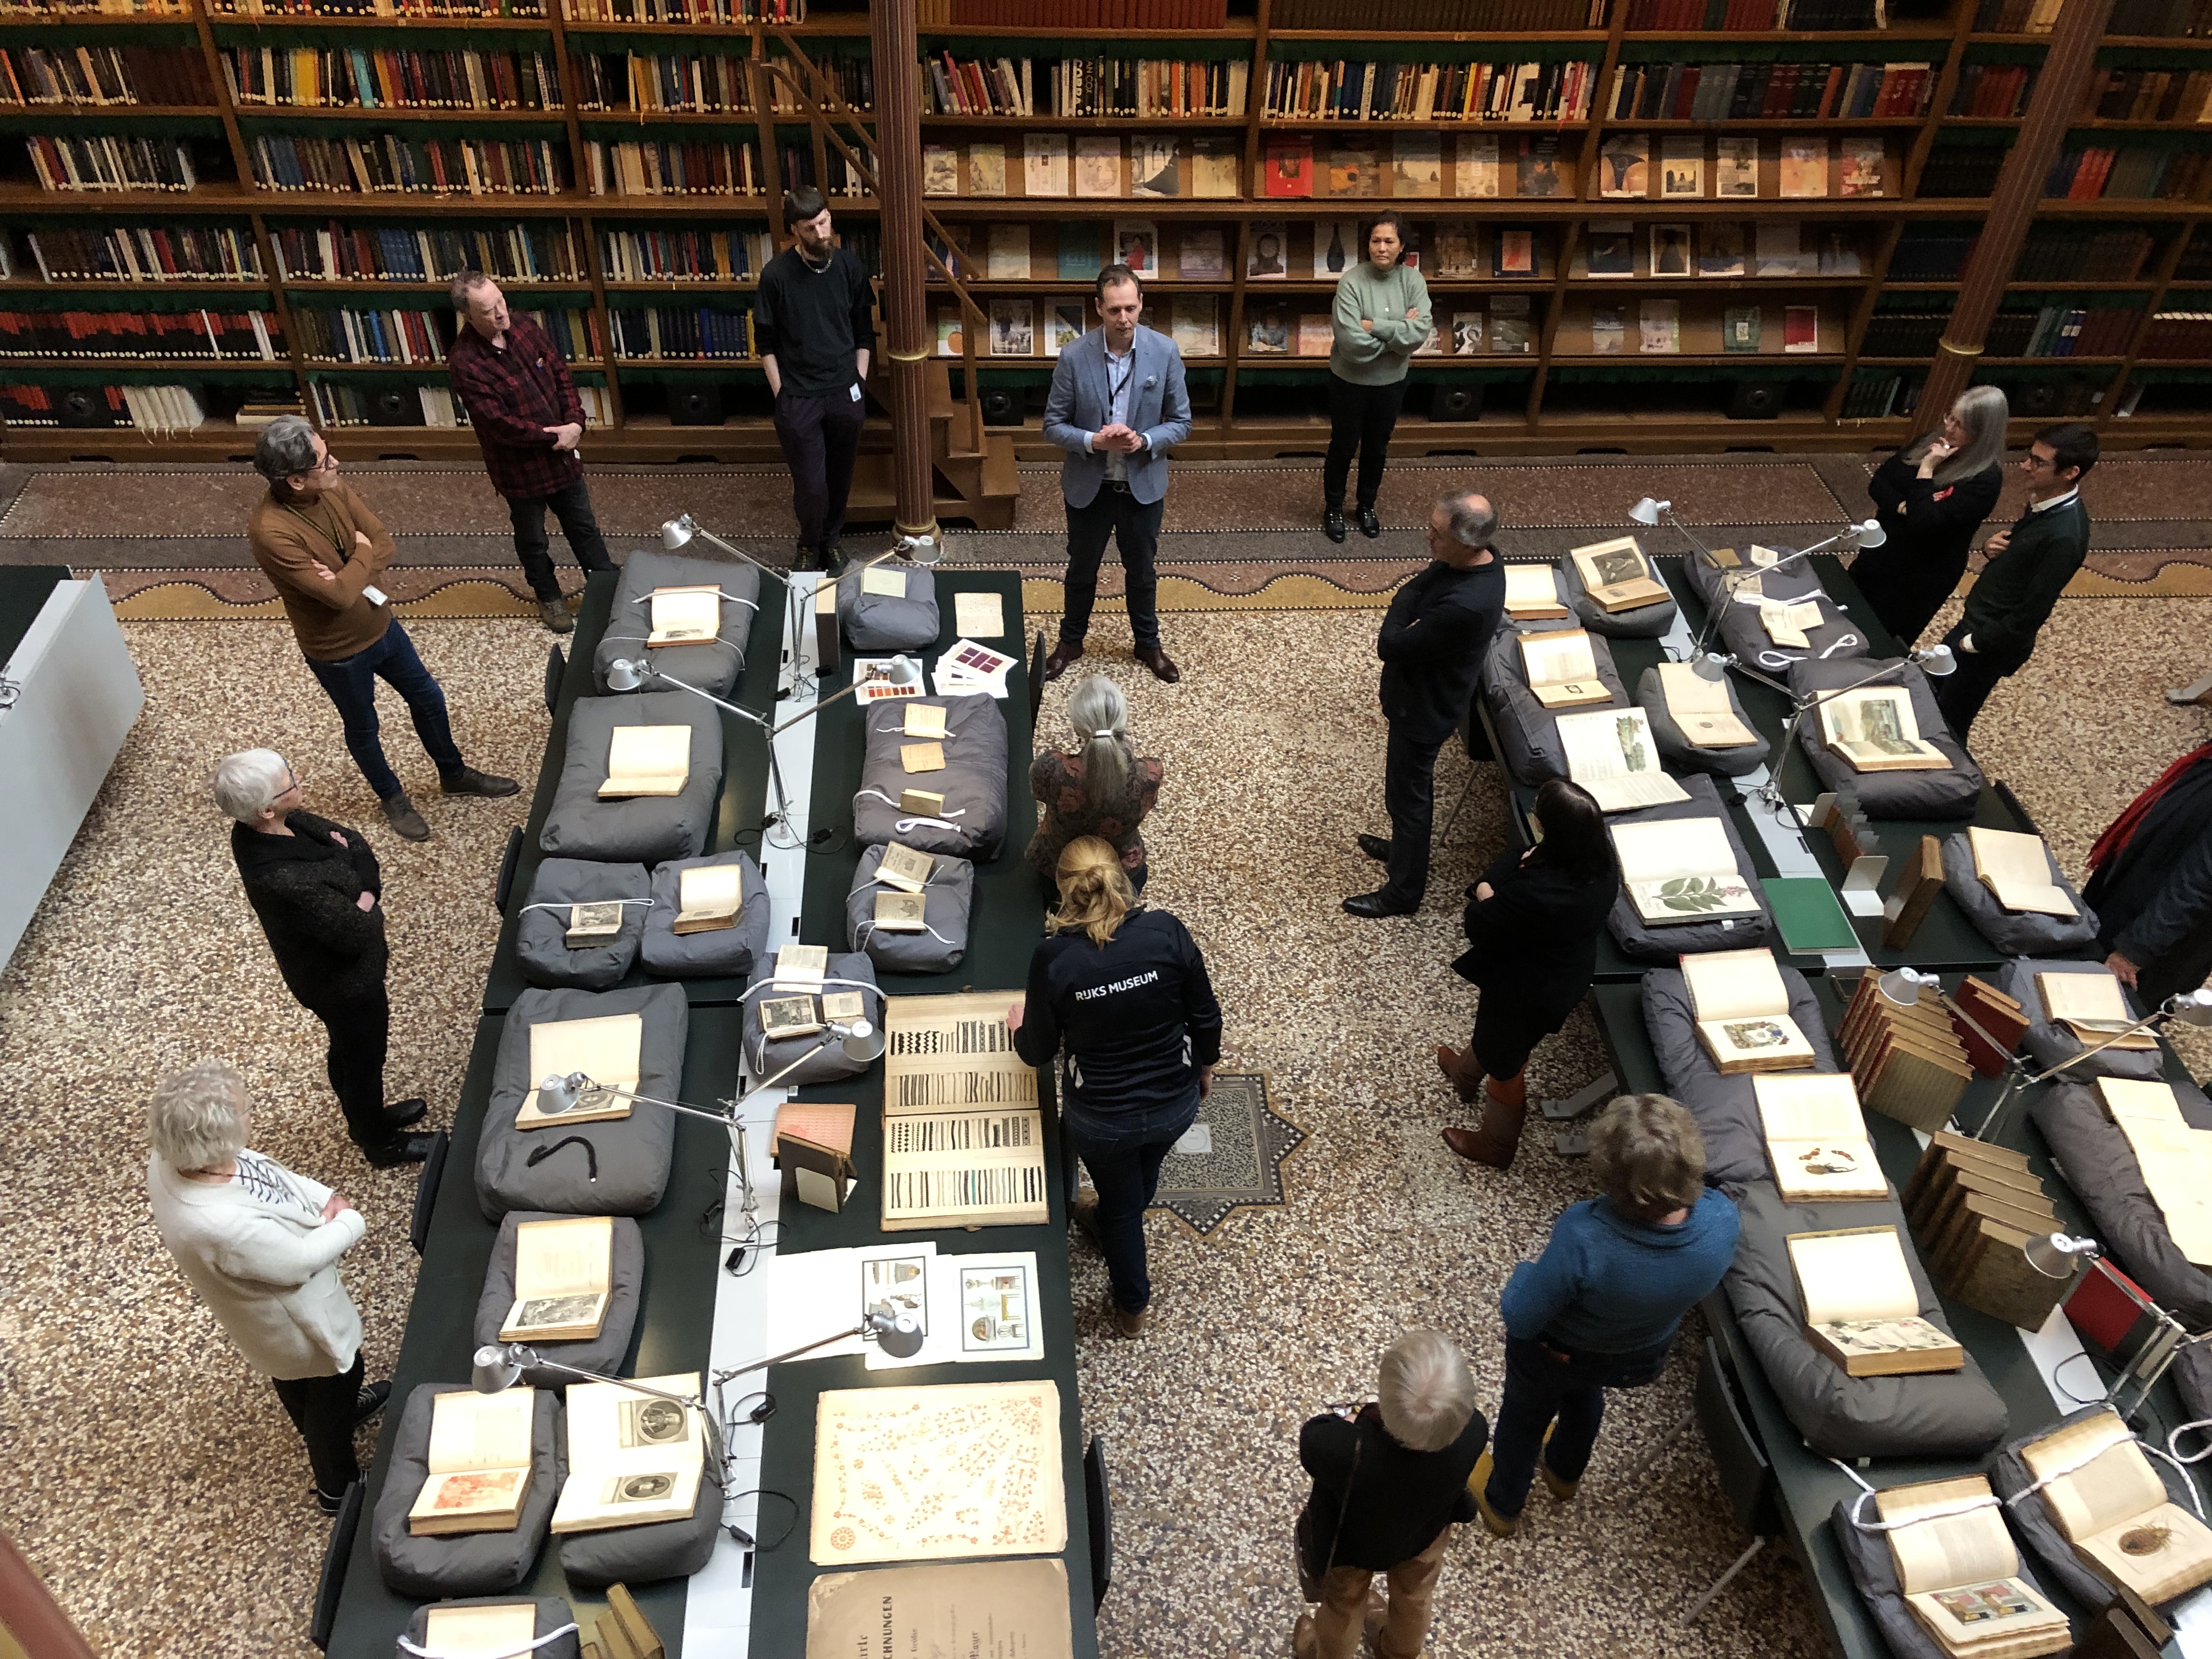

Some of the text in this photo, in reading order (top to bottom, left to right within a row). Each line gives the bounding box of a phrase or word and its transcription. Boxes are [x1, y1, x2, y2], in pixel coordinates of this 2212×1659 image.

[1075, 970, 1158, 1001] RIJKS MUSEUM
[883, 1596, 893, 1659] CHNUNGEN
